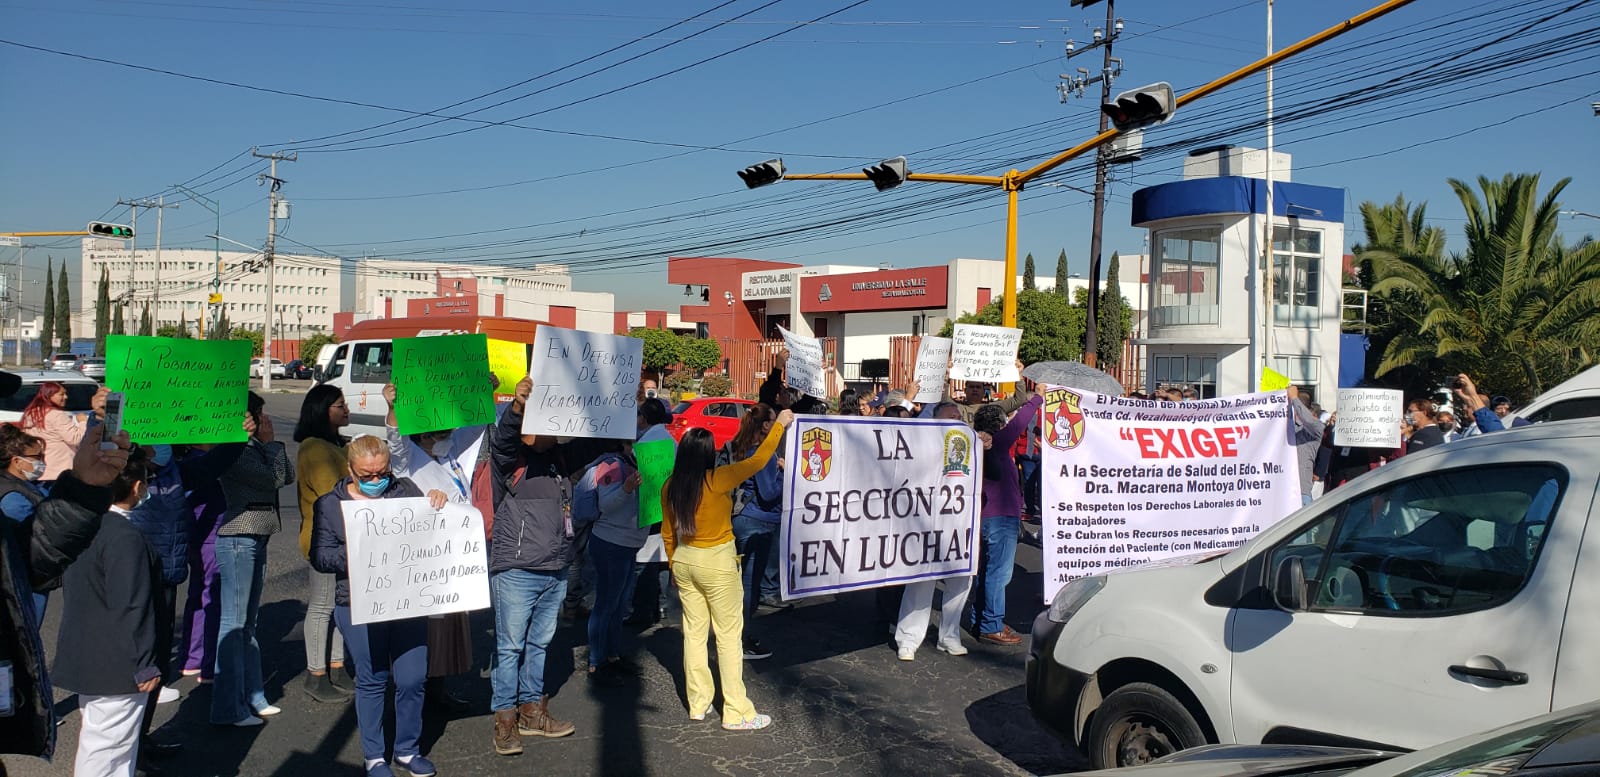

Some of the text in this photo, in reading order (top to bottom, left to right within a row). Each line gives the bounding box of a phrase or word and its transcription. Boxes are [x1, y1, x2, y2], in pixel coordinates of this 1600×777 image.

[895, 279, 905, 288] LA
[905, 277, 928, 288] SALLE
[547, 337, 570, 359] EN
[953, 357, 990, 366] PETITORIO
[963, 366, 1001, 378] SNTSA
[1096, 394, 1107, 404] El
[1110, 396, 1157, 409] Personal
[1160, 399, 1176, 409] del
[1178, 400, 1219, 411] Hospital
[1220, 399, 1233, 409] Dr.
[1351, 402, 1380, 412] abasto
[1382, 402, 1393, 412] de
[415, 397, 488, 430] SNTSA
[1083, 408, 1113, 420] Prada
[1115, 410, 1132, 421] Cd.
[1134, 411, 1211, 424] Nezahualcóyotl
[1212, 409, 1257, 423] (Guardia
[547, 415, 611, 433] SNTSA
[1338, 425, 1382, 434] materiales
[873, 429, 914, 461] LA
[1059, 464, 1069, 478] A
[1073, 464, 1087, 478] la
[1090, 464, 1163, 478] Secretaría
[1166, 464, 1182, 477] de
[1184, 463, 1217, 477] Salud
[1220, 463, 1237, 476] del
[1239, 463, 1260, 476] Edo.
[1085, 478, 1271, 495] Dra. Macarena Montoya Olvera
[802, 479, 965, 525] SECCIÓN 23
[1058, 497, 1262, 513] Se Respeten los Derechos Laborales de los
[461, 515, 470, 529] A
[1057, 516, 1126, 527] trabajadores
[1057, 523, 1260, 540] Se Cubran los Recursos necesarios para la
[1057, 537, 1248, 554] atención del Paciente (con Medicament
[368, 551, 388, 569] LA
[462, 540, 480, 554] DE
[790, 528, 971, 590] ¡EN LUCHA!
[1057, 558, 1102, 570] equipos
[370, 601, 386, 616] DE
[396, 598, 410, 611] LA
